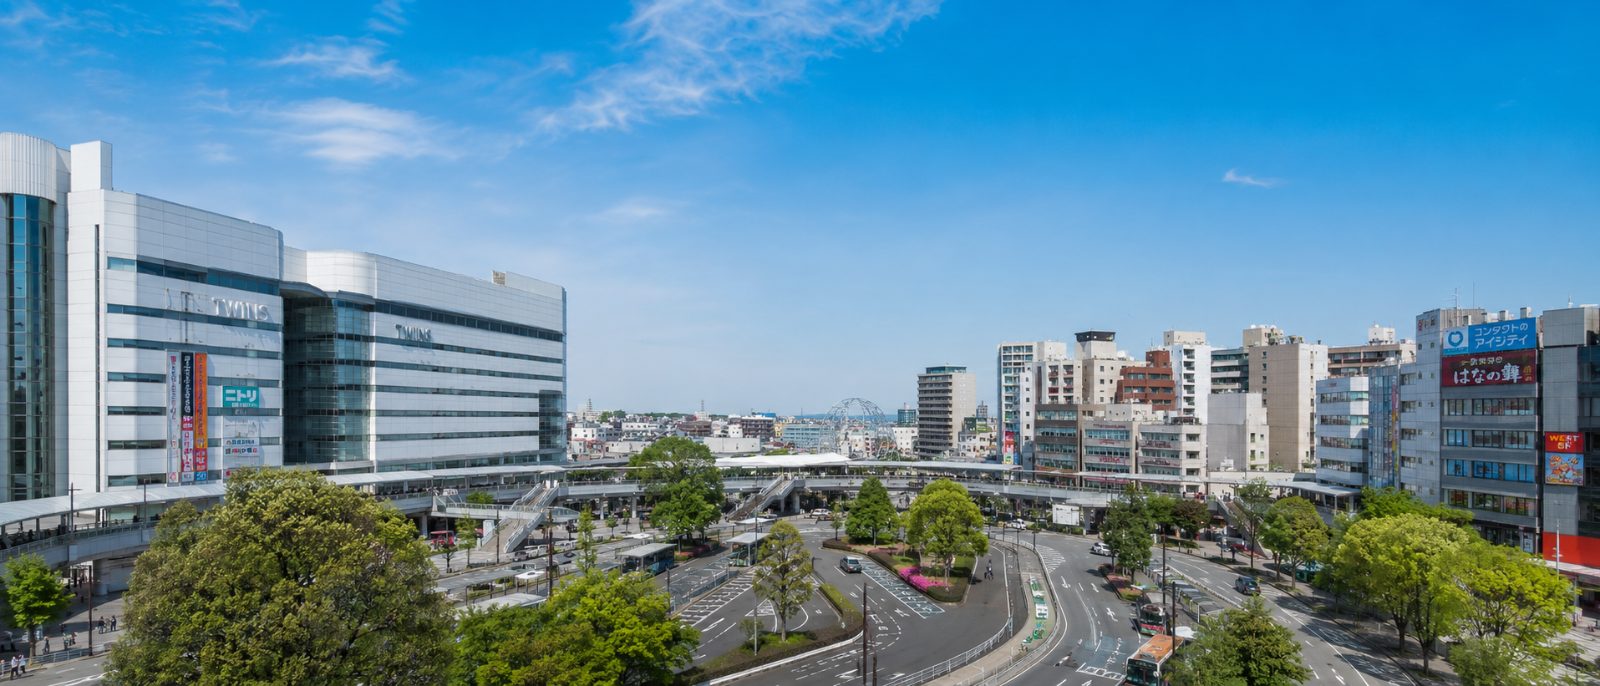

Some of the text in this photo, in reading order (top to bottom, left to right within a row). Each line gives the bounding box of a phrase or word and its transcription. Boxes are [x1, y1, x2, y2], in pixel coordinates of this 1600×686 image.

[1475, 323, 1529, 337] コンタクトの
[225, 389, 257, 403] ニトリ
